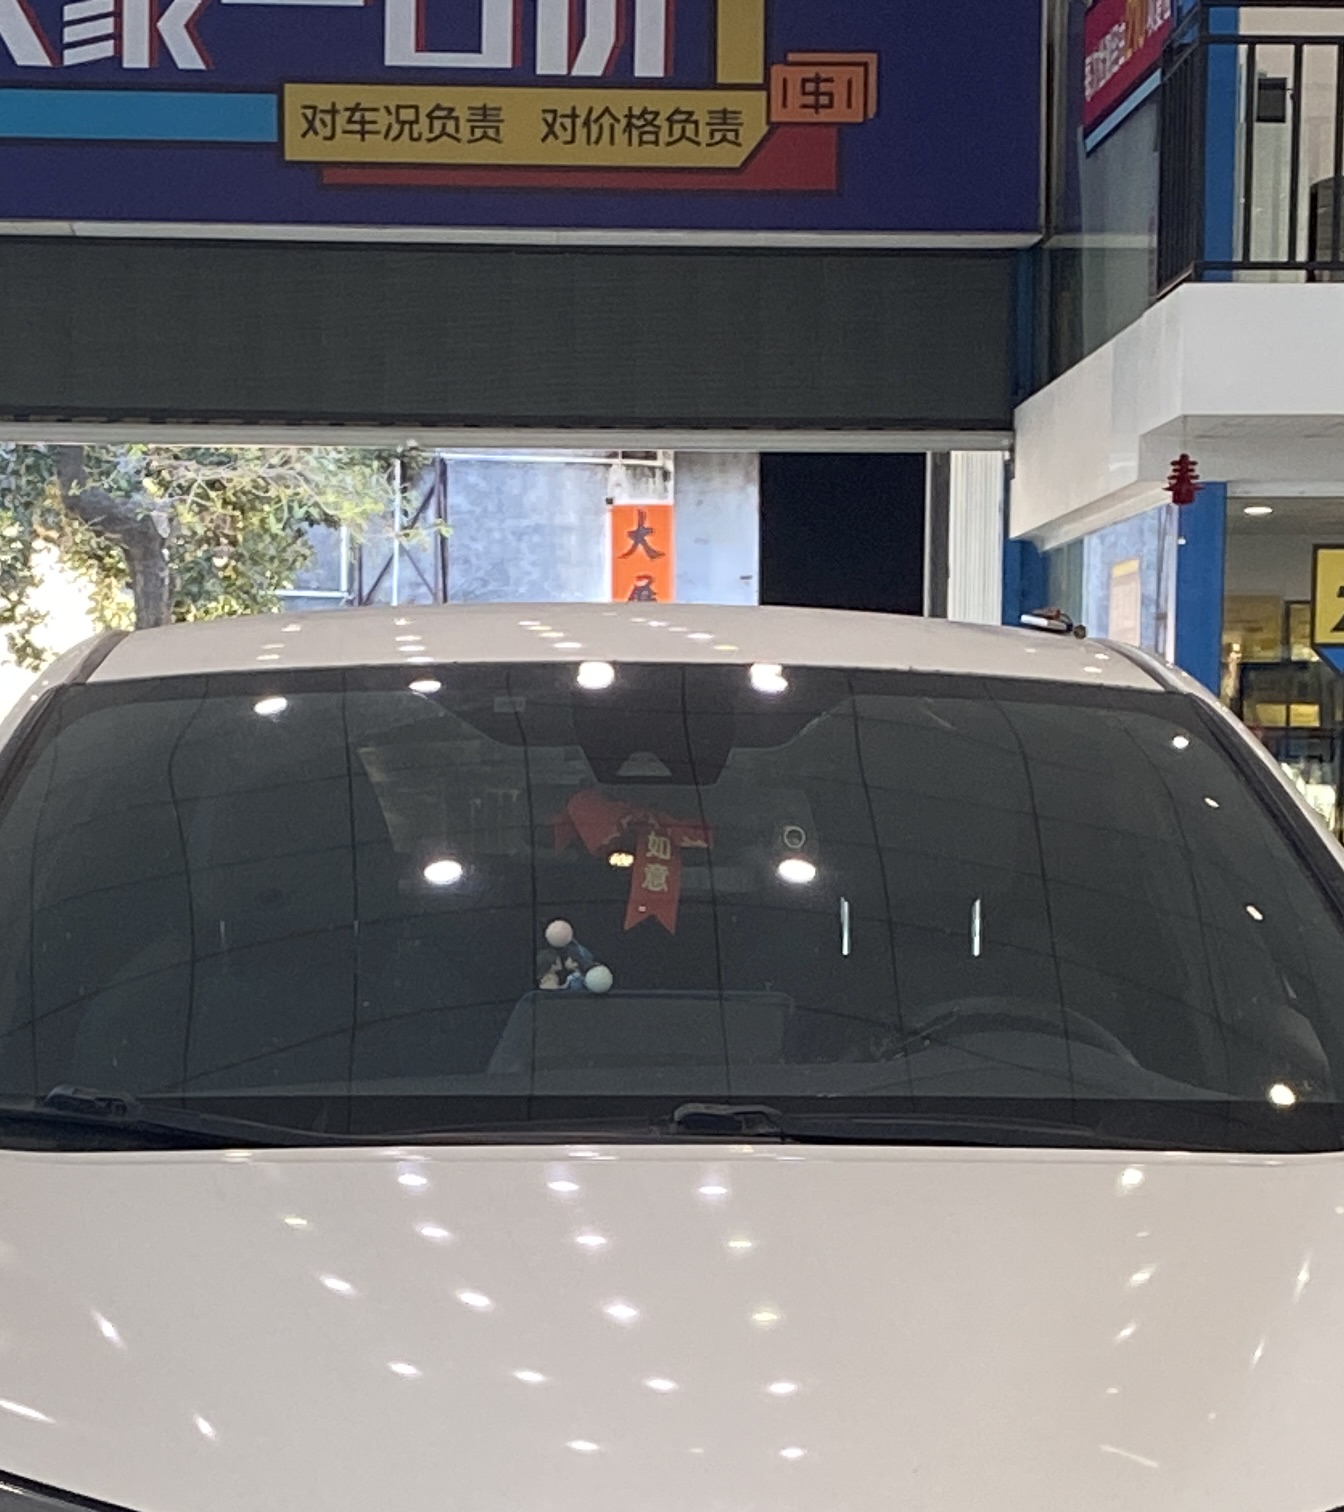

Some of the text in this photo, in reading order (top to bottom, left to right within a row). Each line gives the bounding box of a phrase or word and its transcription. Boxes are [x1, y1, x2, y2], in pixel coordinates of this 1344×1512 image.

[299, 100, 504, 144] 对车况负责
[540, 105, 745, 147] 对价格负责
